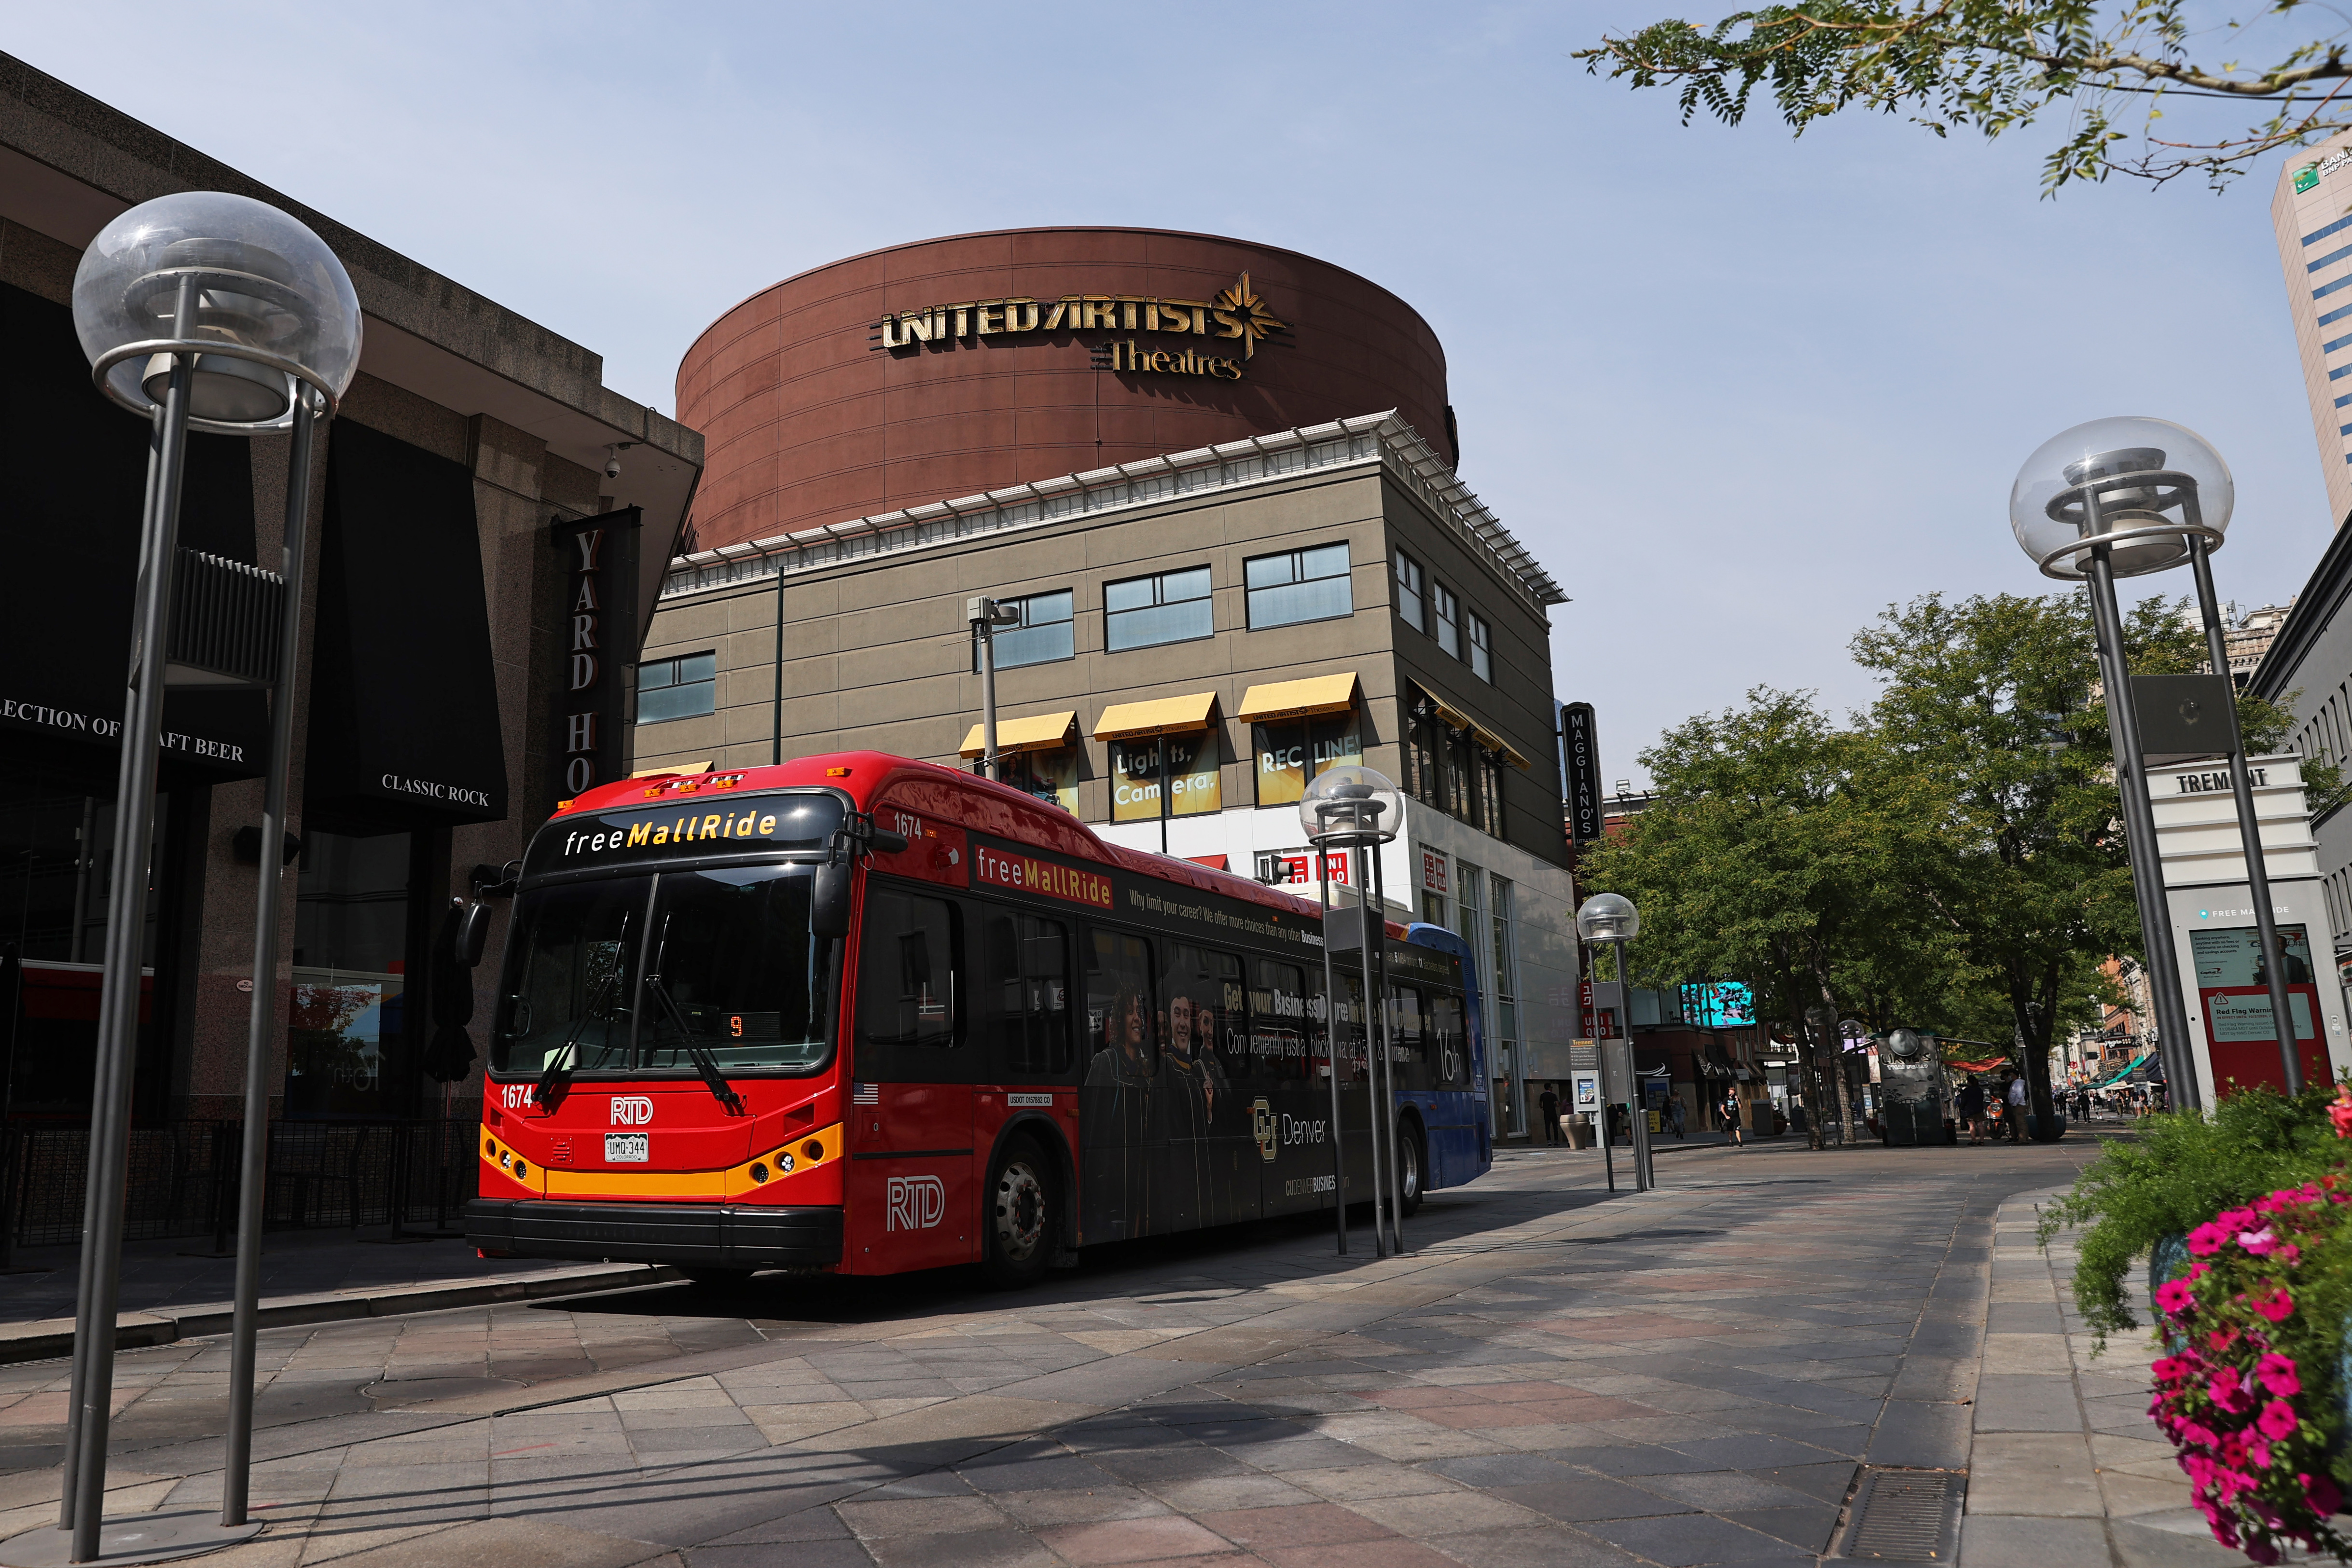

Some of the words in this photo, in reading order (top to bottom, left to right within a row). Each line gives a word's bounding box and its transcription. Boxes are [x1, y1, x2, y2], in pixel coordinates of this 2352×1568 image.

[2323, 164, 2340, 177] BNP
[882, 297, 1038, 348] UNITED
[1043, 294, 1243, 338] ARTISTS
[1104, 339, 1241, 380] Theatres
[571, 530, 601, 690] YARD
[1276, 709, 1303, 717] ARTISTS
[0, 699, 87, 731] ECTION
[93, 718, 121, 737] OF
[159, 731, 190, 751] AFT
[194, 738, 244, 762] BEER
[1134, 728, 1159, 736] ARTISTS
[1571, 714, 1593, 833] MAGGIANO'S
[382, 774, 444, 798] CLASSIC
[448, 786, 489, 806] ROCK
[1115, 774, 1214, 805] Camera,
[565, 811, 776, 856] freeMallRide
[894, 812, 922, 839] 1674
[979, 848, 1109, 904] freeMallRide
[1328, 857, 1342, 869] NI
[1129, 889, 1144, 911] Why
[1146, 893, 1162, 911] limit
[1163, 900, 1177, 916] your
[1179, 904, 1202, 920] career?
[1204, 907, 1213, 923] We
[1214, 910, 1228, 926] offer
[1229, 916, 1243, 930] more
[1245, 917, 1264, 934] choices
[1265, 922, 1277, 936] than
[1278, 927, 1287, 942] any
[1288, 927, 1301, 942] other
[1301, 930, 1323, 947] Business
[1395, 951, 1397, 963] 5
[1418, 957, 1423, 968] 11
[1224, 982, 1244, 1011] Get
[1248, 990, 1272, 1018] your
[731, 1016, 742, 1037] 9
[1585, 1016, 1603, 1026] UI
[1301, 1038, 1306, 1057] a
[1310, 1033, 1329, 1058] block
[1349, 1038, 1356, 1059] at
[1358, 1039, 1368, 1059] 15
[1378, 1039, 1384, 1061] &
[502, 1085, 532, 1108] 1674
[611, 1096, 653, 1125] RTD
[1283, 1114, 1326, 1145] Denver
[887, 1175, 945, 1232] RTD
